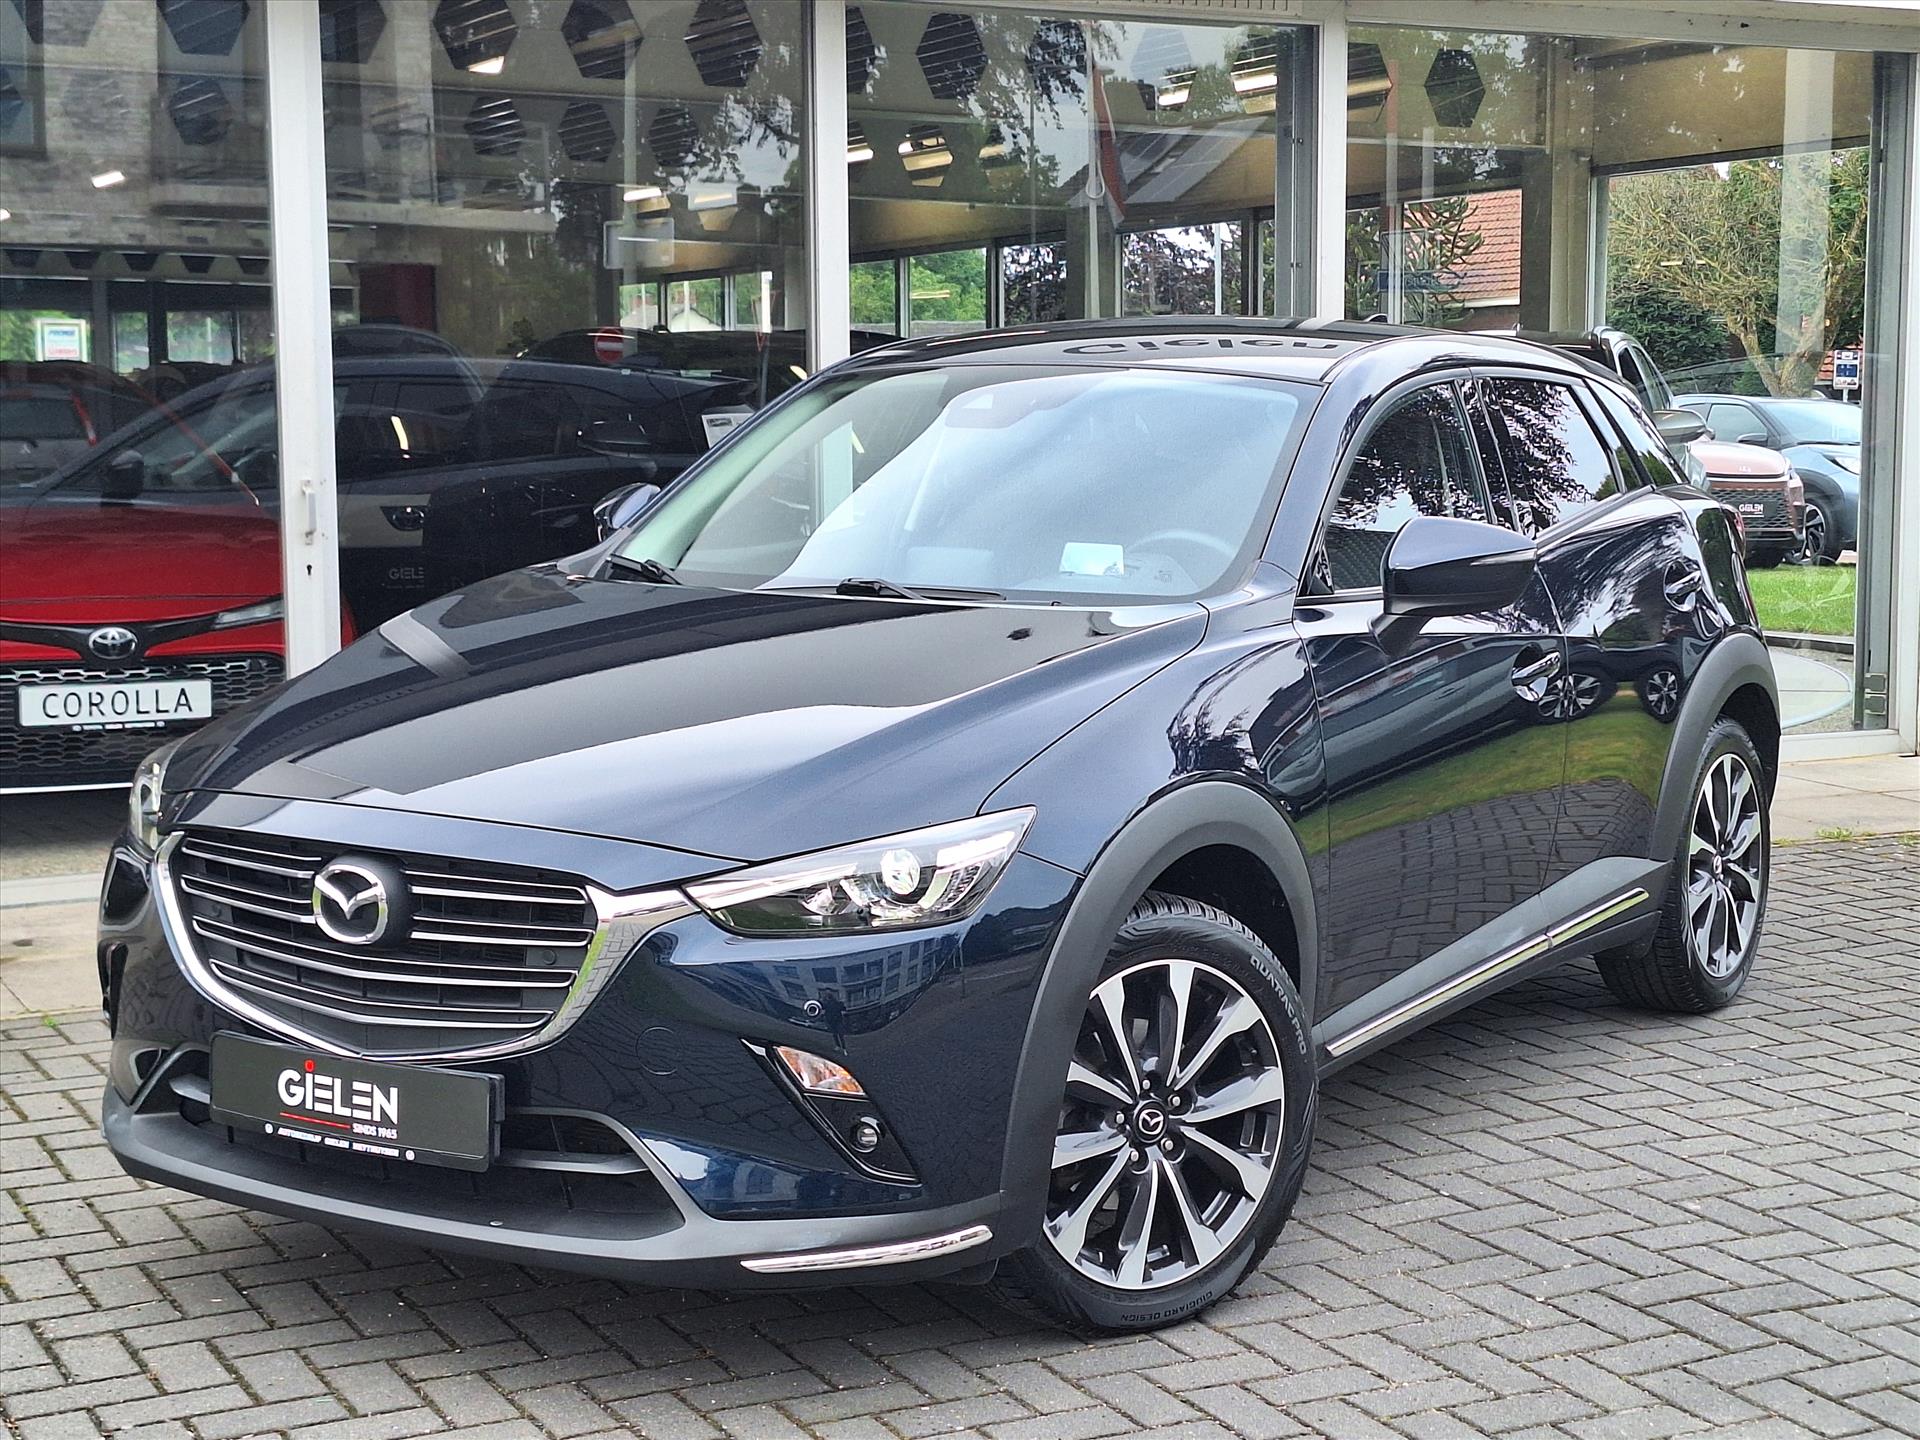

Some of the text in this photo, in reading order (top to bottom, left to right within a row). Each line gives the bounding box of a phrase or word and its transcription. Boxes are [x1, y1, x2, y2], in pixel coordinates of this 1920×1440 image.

[388, 566, 425, 580] GIELE
[43, 688, 193, 719] COROLLA
[1250, 955, 1307, 1055] QUATRAC PRO
[277, 1059, 399, 1124] GIELEN
[352, 1123, 398, 1139] SINDS 1965
[1120, 1291, 1213, 1322] GIUGIARO DESIGN
